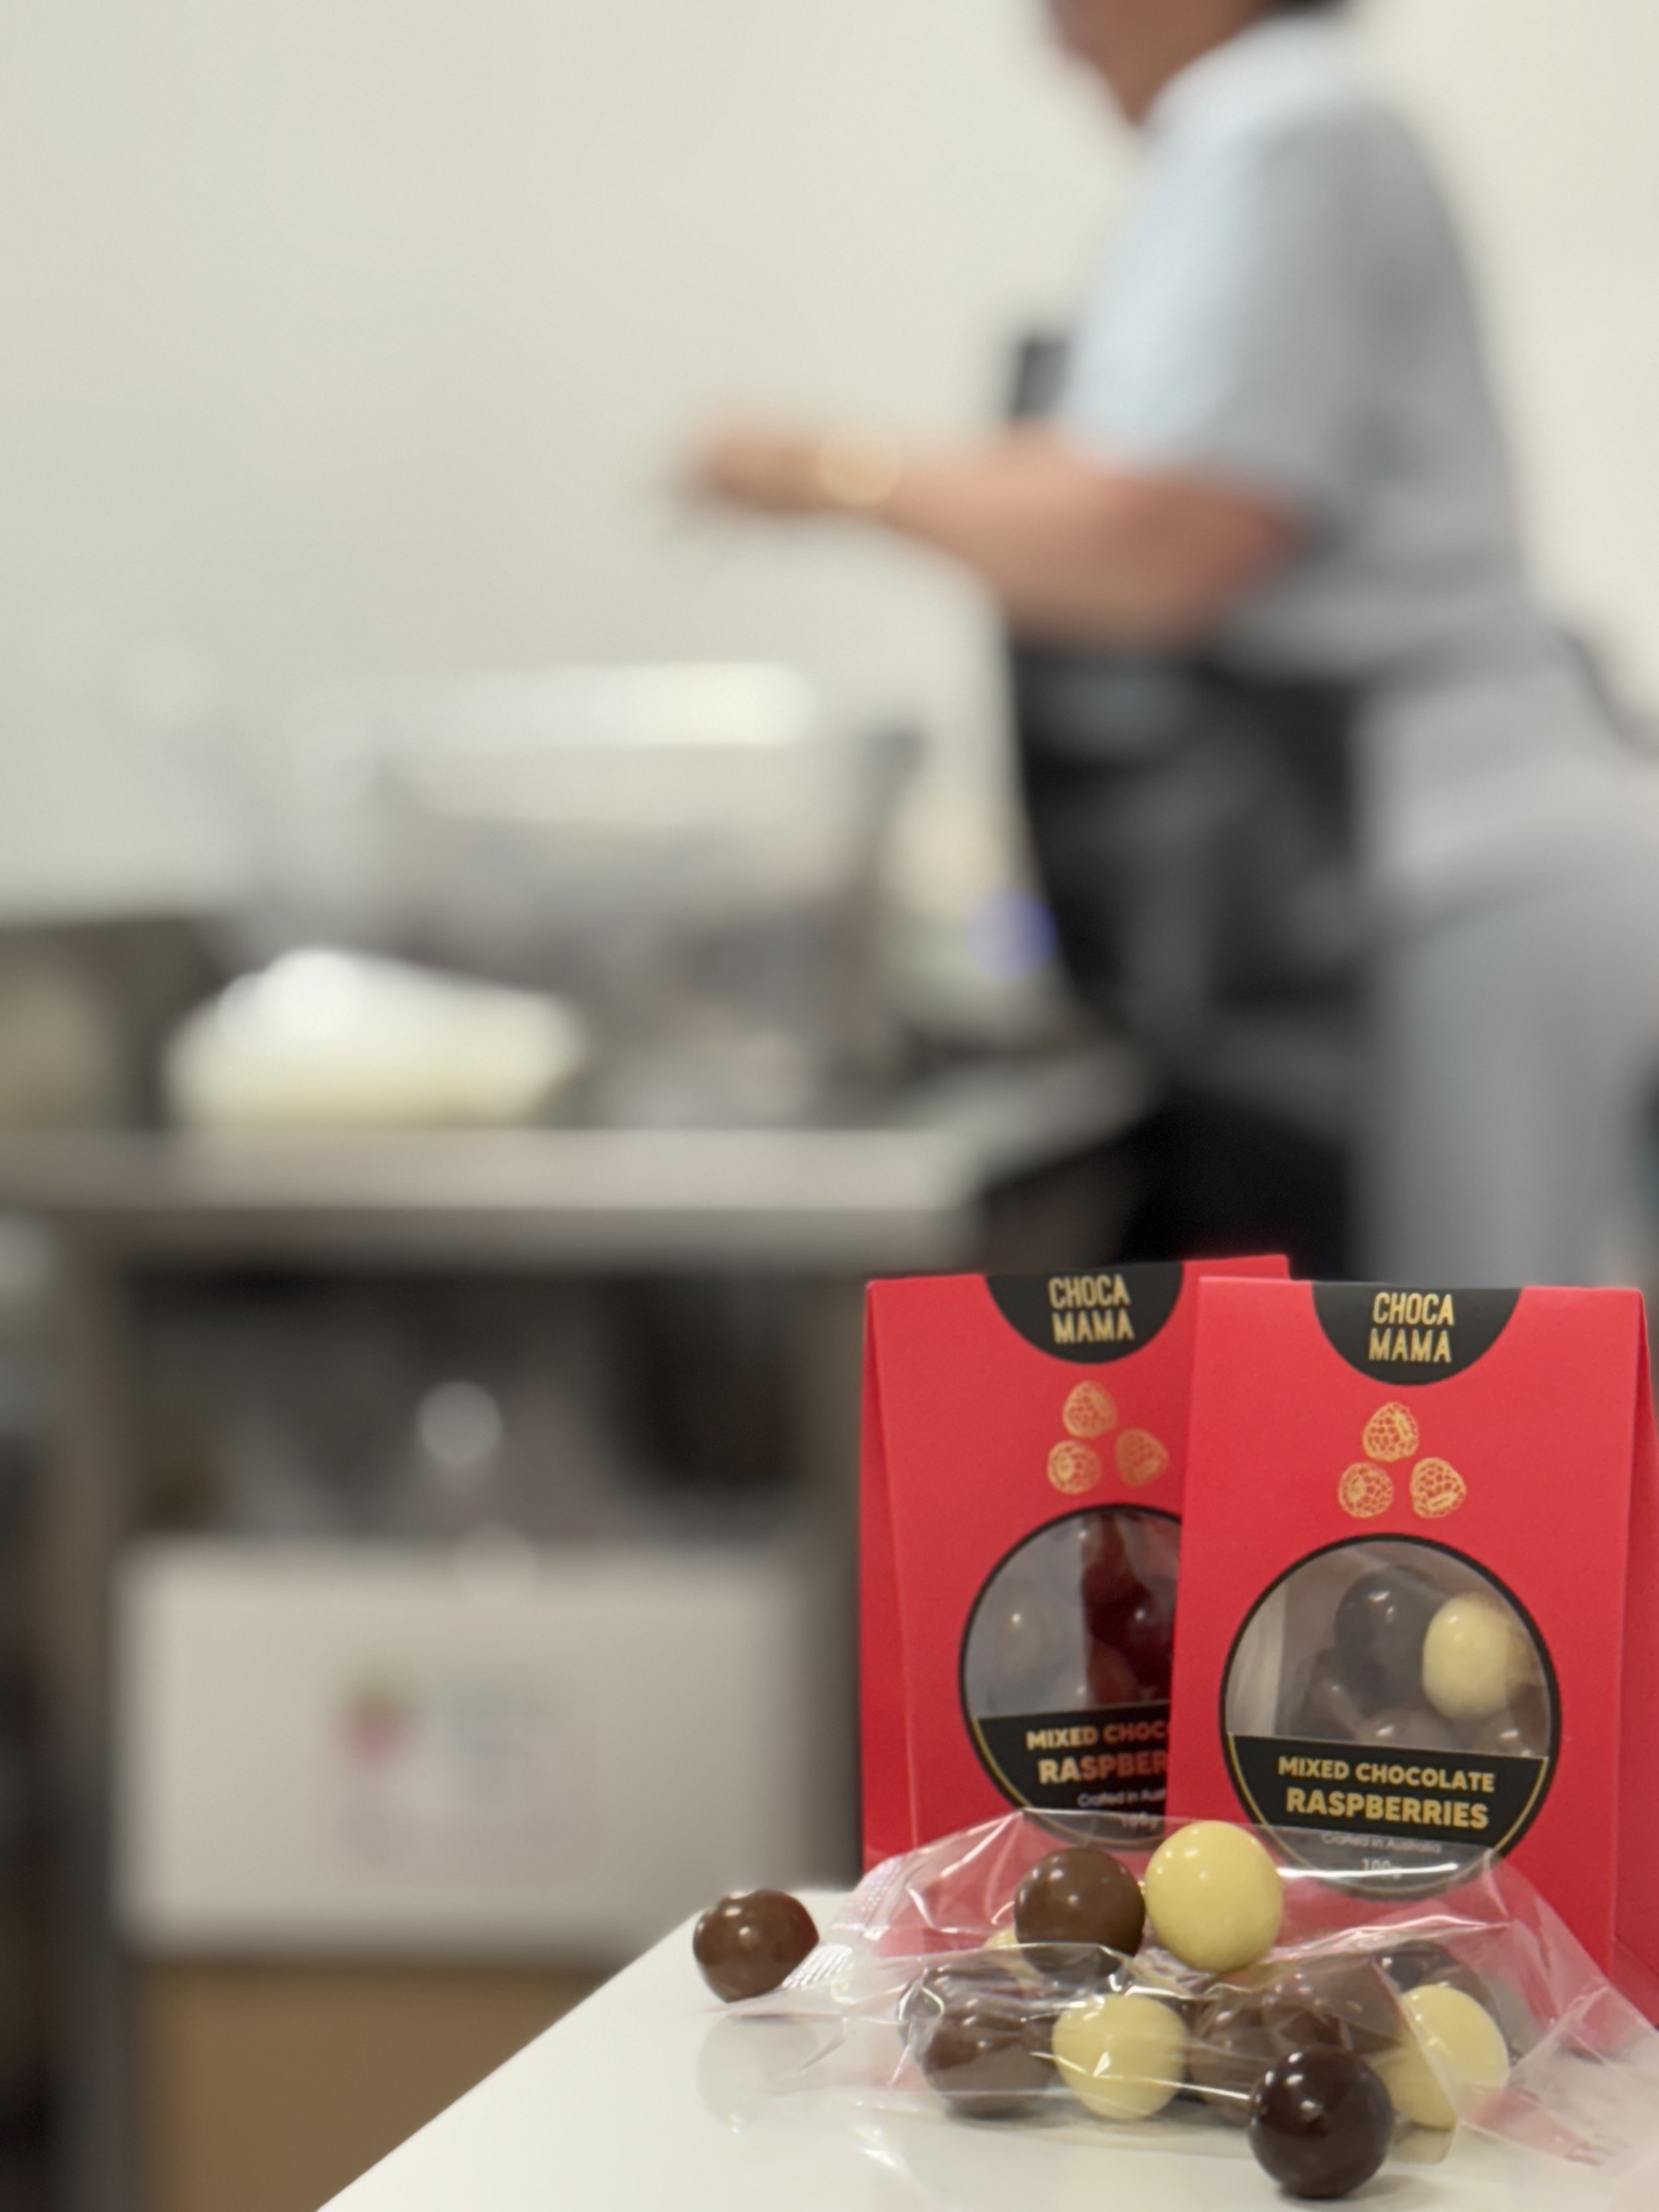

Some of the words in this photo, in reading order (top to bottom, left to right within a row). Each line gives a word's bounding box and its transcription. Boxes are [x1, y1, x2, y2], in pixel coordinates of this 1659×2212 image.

[1048, 1273, 1131, 1309] CHOCA
[1372, 1291, 1455, 1325] CHOCA
[1052, 1307, 1135, 1345] MAMA
[1368, 1327, 1452, 1363] MAMA
[1027, 1726, 1098, 1750] MIXED
[1278, 1756, 1350, 1780] MIXED
[1355, 1762, 1495, 1793] CHOCOLATE
[1287, 1787, 1488, 1829] RASPBERRIES
